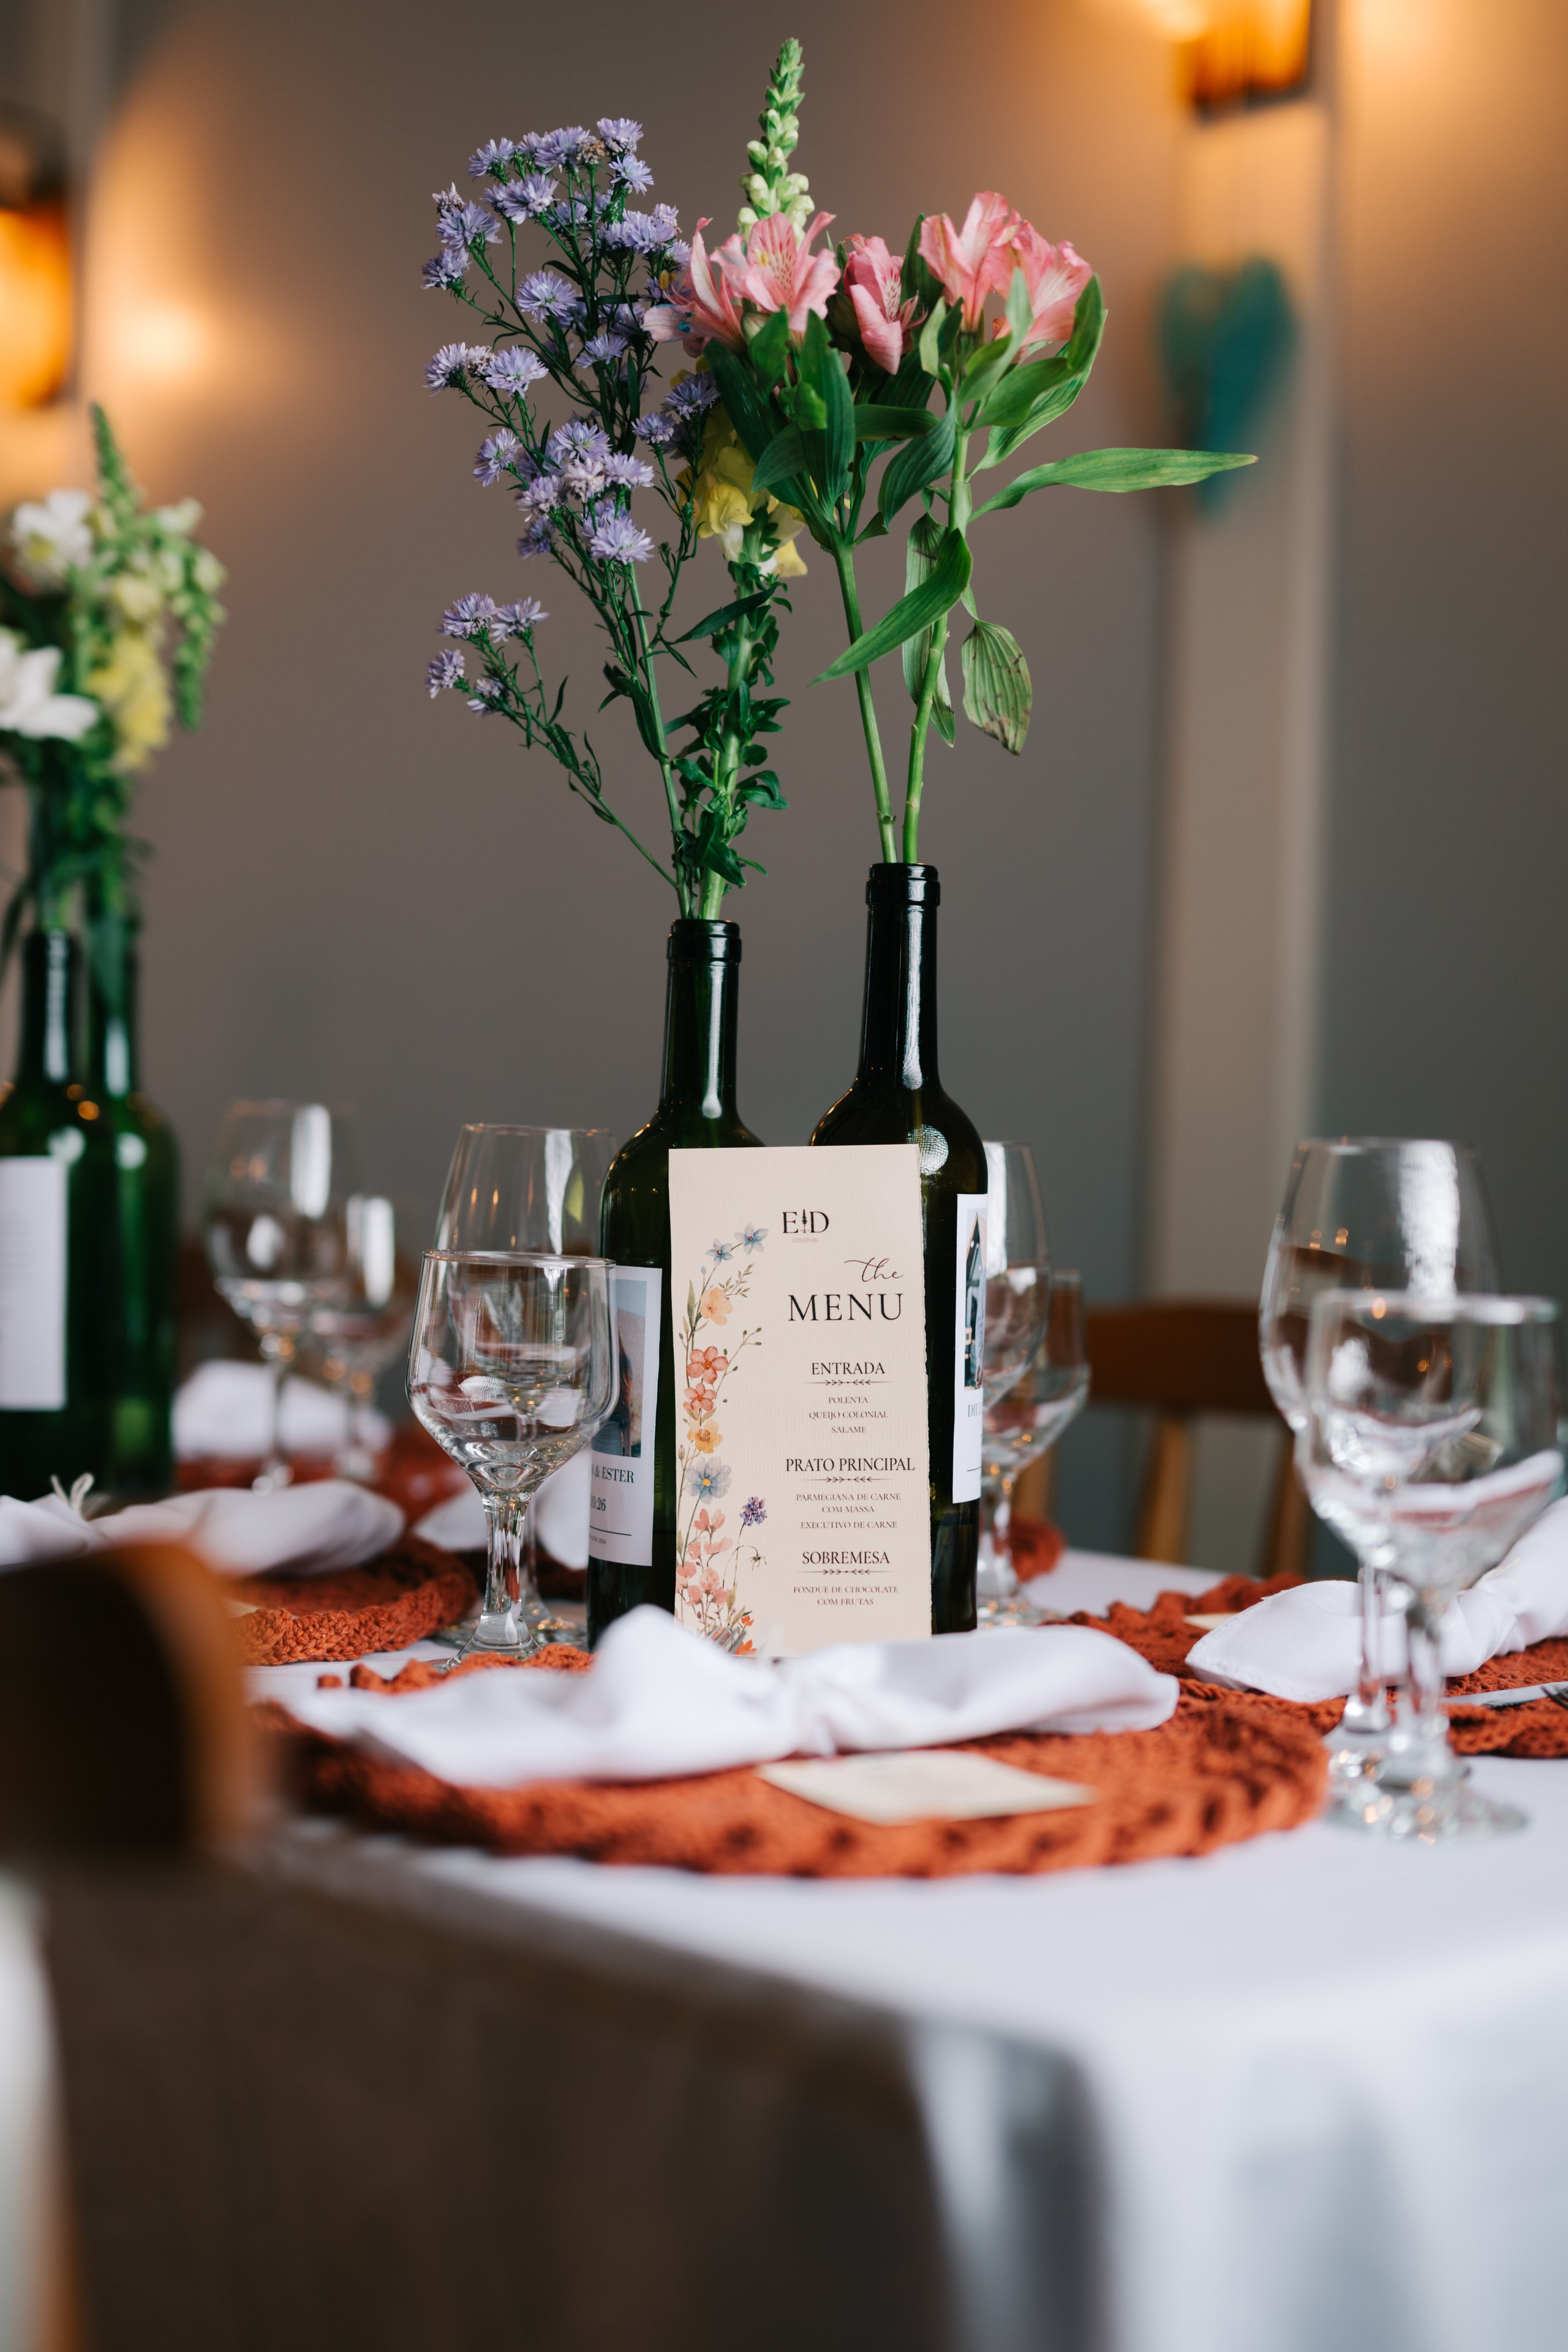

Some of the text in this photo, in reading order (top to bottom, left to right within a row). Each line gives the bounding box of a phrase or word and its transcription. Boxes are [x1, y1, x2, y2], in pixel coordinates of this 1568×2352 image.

[843, 1257, 904, 1282] the
[788, 1293, 904, 1321] MENU
[812, 1362, 886, 1375] ENTRADA
[809, 1411, 840, 1420] QUEIJO
[786, 1458, 916, 1472] PRATO PRINCIPAL
[595, 1464, 600, 1478] &
[602, 1466, 635, 1483] ESTER
[802, 1551, 891, 1565] SOBREMESA
